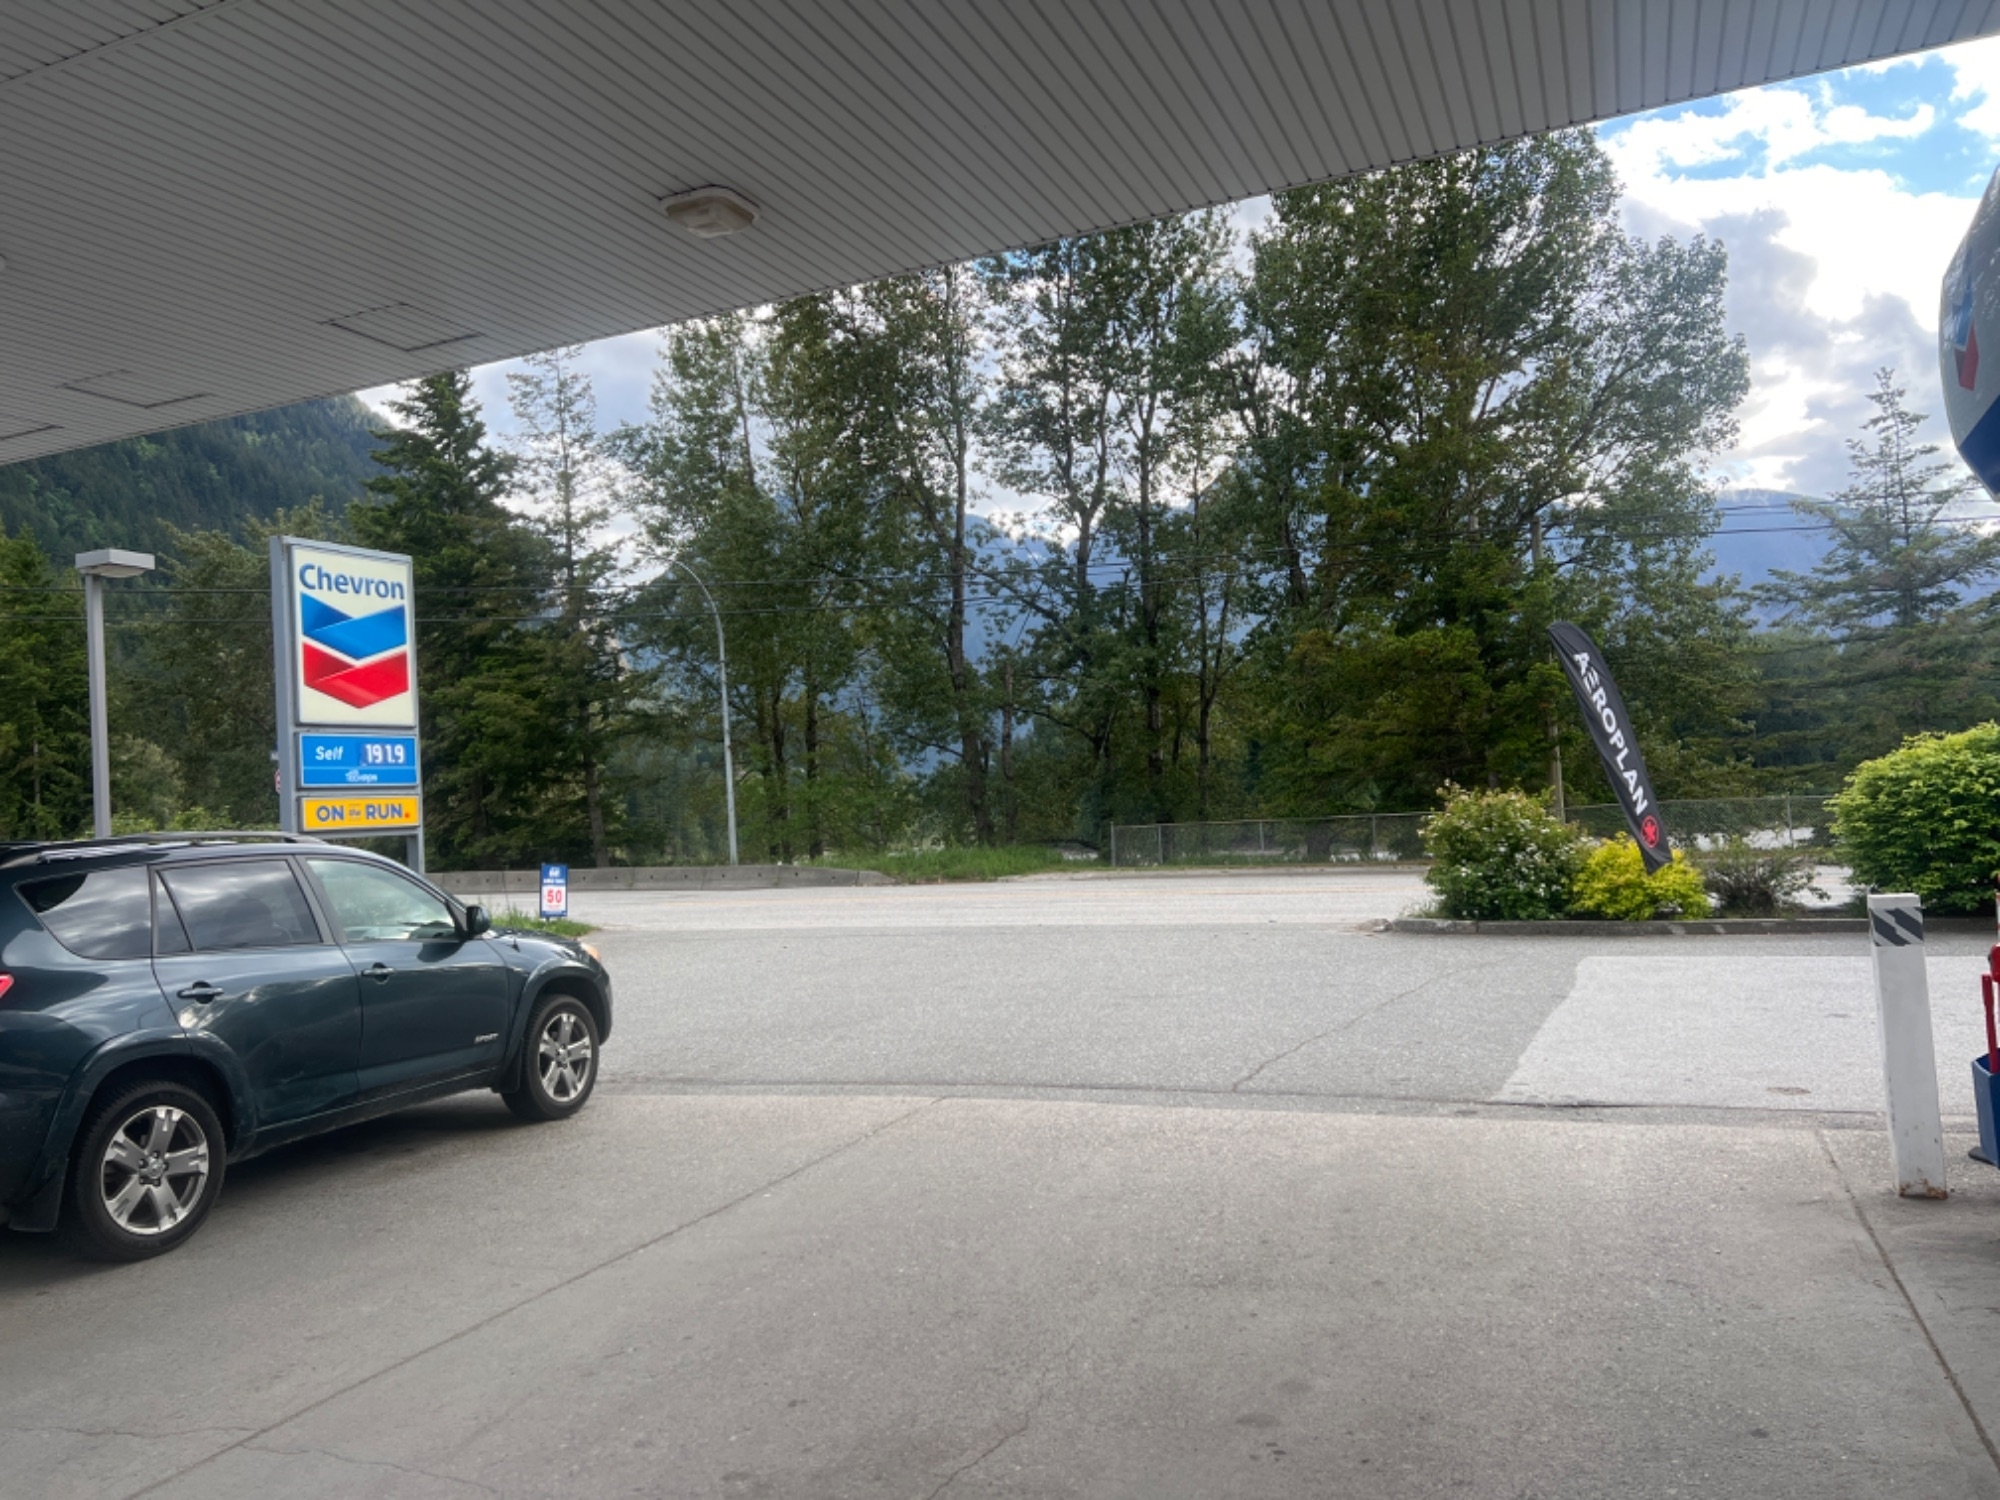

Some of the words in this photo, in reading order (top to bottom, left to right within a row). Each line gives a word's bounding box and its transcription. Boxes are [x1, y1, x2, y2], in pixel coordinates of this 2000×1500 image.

[299, 563, 405, 600] Chevron
[1573, 651, 1648, 816] AEROPLAN
[315, 745, 344, 761] Self
[365, 743, 405, 764] 191.9
[316, 805, 345, 822] ON
[547, 889, 562, 903] 50
